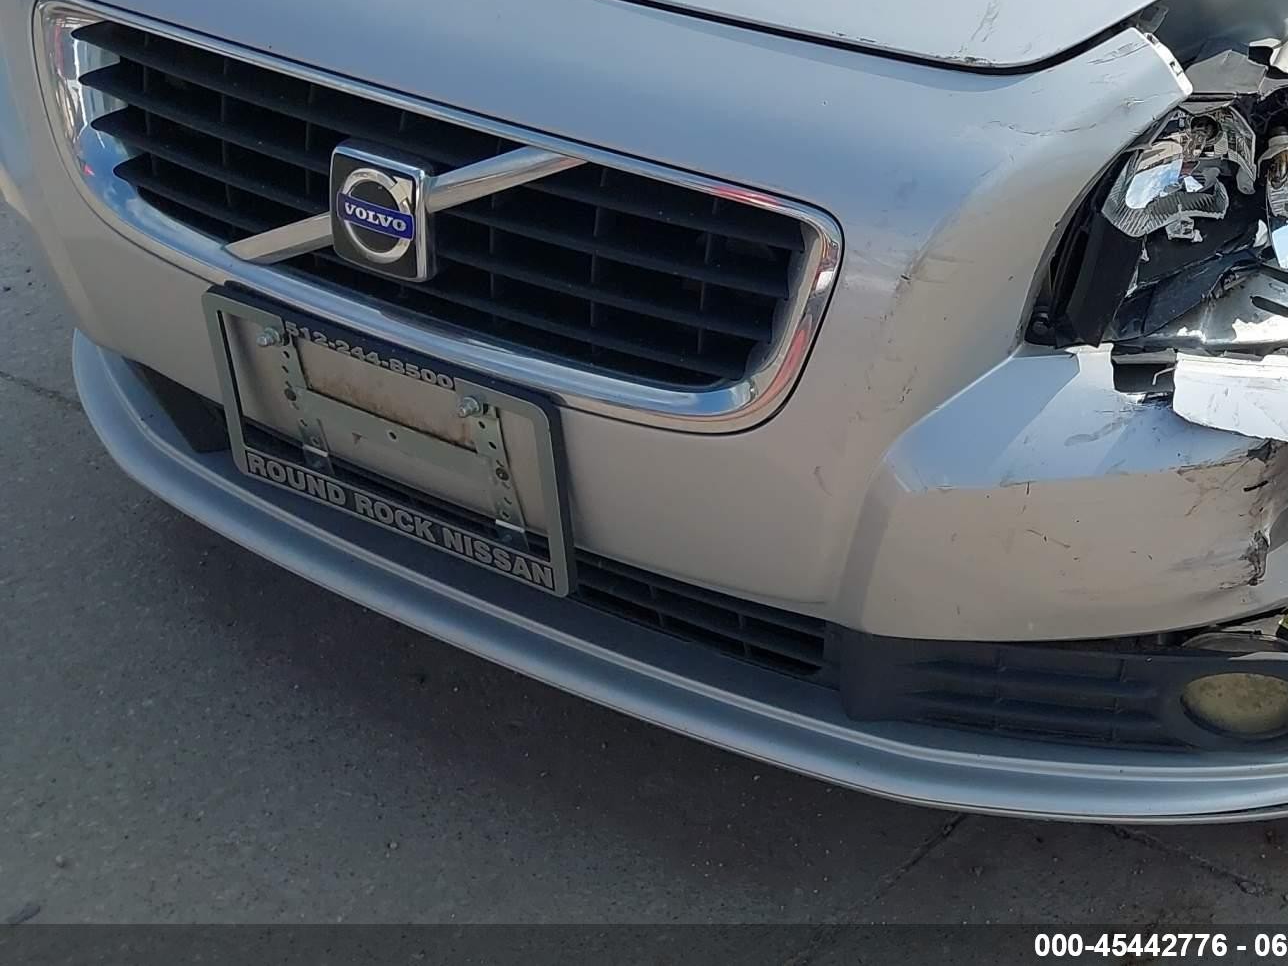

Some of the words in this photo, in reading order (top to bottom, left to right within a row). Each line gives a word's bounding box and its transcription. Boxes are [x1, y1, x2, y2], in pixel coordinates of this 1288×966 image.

[344, 201, 407, 232] VOLVO
[284, 320, 454, 390] 512-244-8500
[247, 452, 347, 506] ROUND
[354, 492, 437, 543] ROCK
[442, 527, 554, 590] NISSAN
